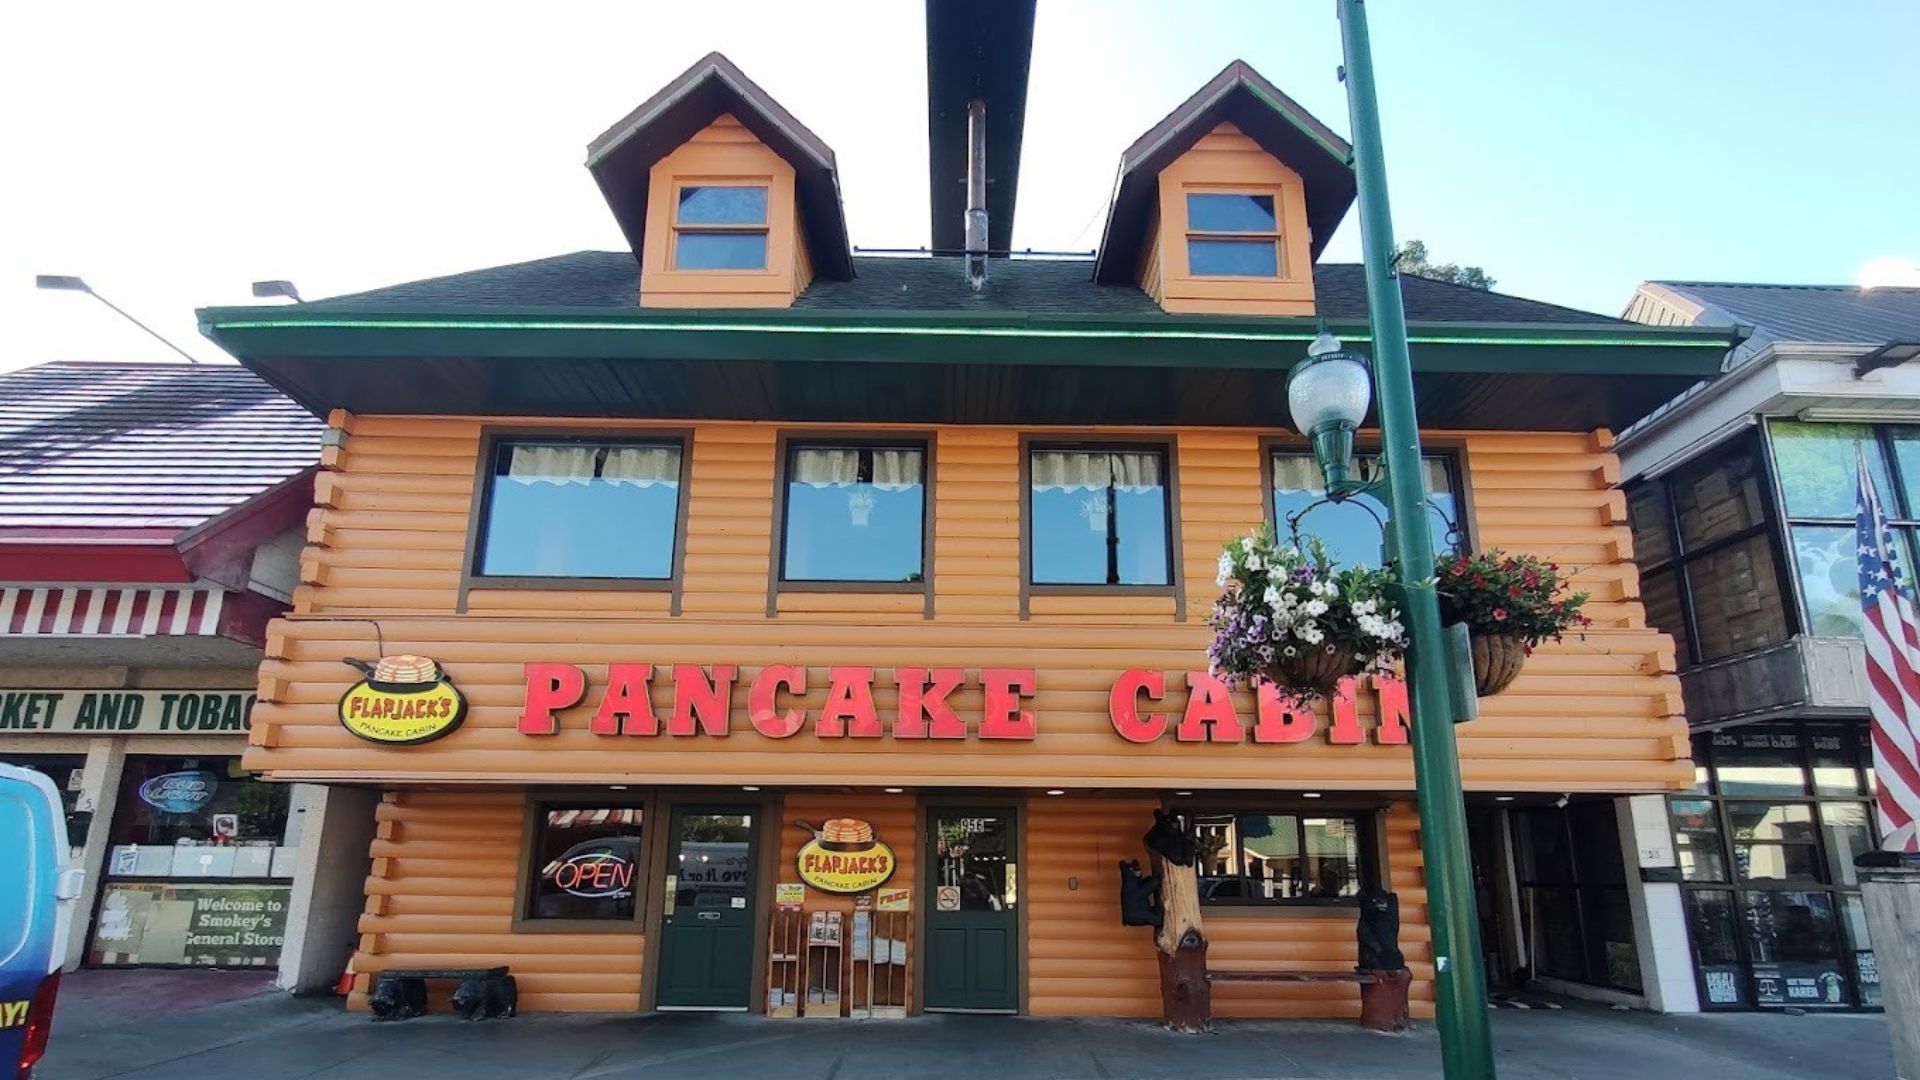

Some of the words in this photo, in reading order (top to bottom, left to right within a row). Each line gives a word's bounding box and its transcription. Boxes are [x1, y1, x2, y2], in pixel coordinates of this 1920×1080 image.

[349, 695, 452, 720] FLAPJACK'S
[518, 662, 1037, 740] PANCAKE
[0, 693, 64, 729] KET
[73, 693, 144, 731] AND
[359, 721, 401, 737] PANCAKE
[406, 722, 437, 736] CABIN
[804, 854, 888, 875] FLAPJACK'S
[555, 862, 635, 890] OPEN
[814, 876, 850, 889] PANCAKE
[852, 877, 878, 889] CABIN
[197, 897, 264, 911] Welcome
[267, 900, 282, 911] to
[198, 914, 272, 930] Smokey's
[242, 932, 284, 945] Store
